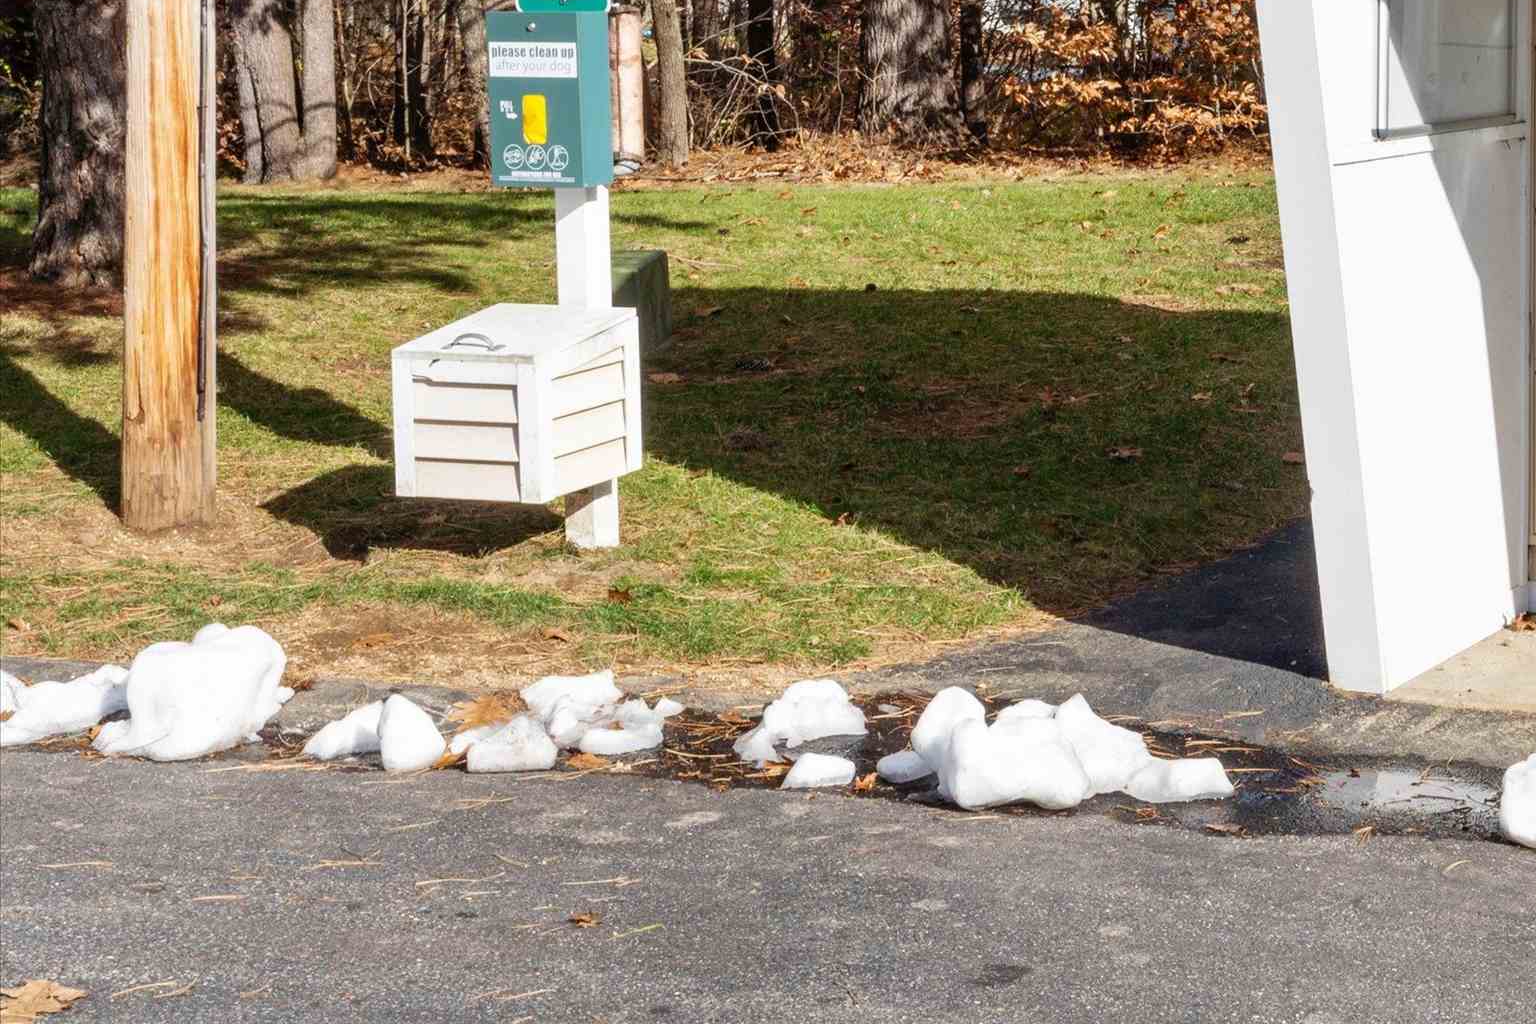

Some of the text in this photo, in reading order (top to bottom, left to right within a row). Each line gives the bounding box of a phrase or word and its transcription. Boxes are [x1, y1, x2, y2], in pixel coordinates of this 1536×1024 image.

[491, 46, 574, 59] please clean up
[495, 60, 572, 74] after your dog
